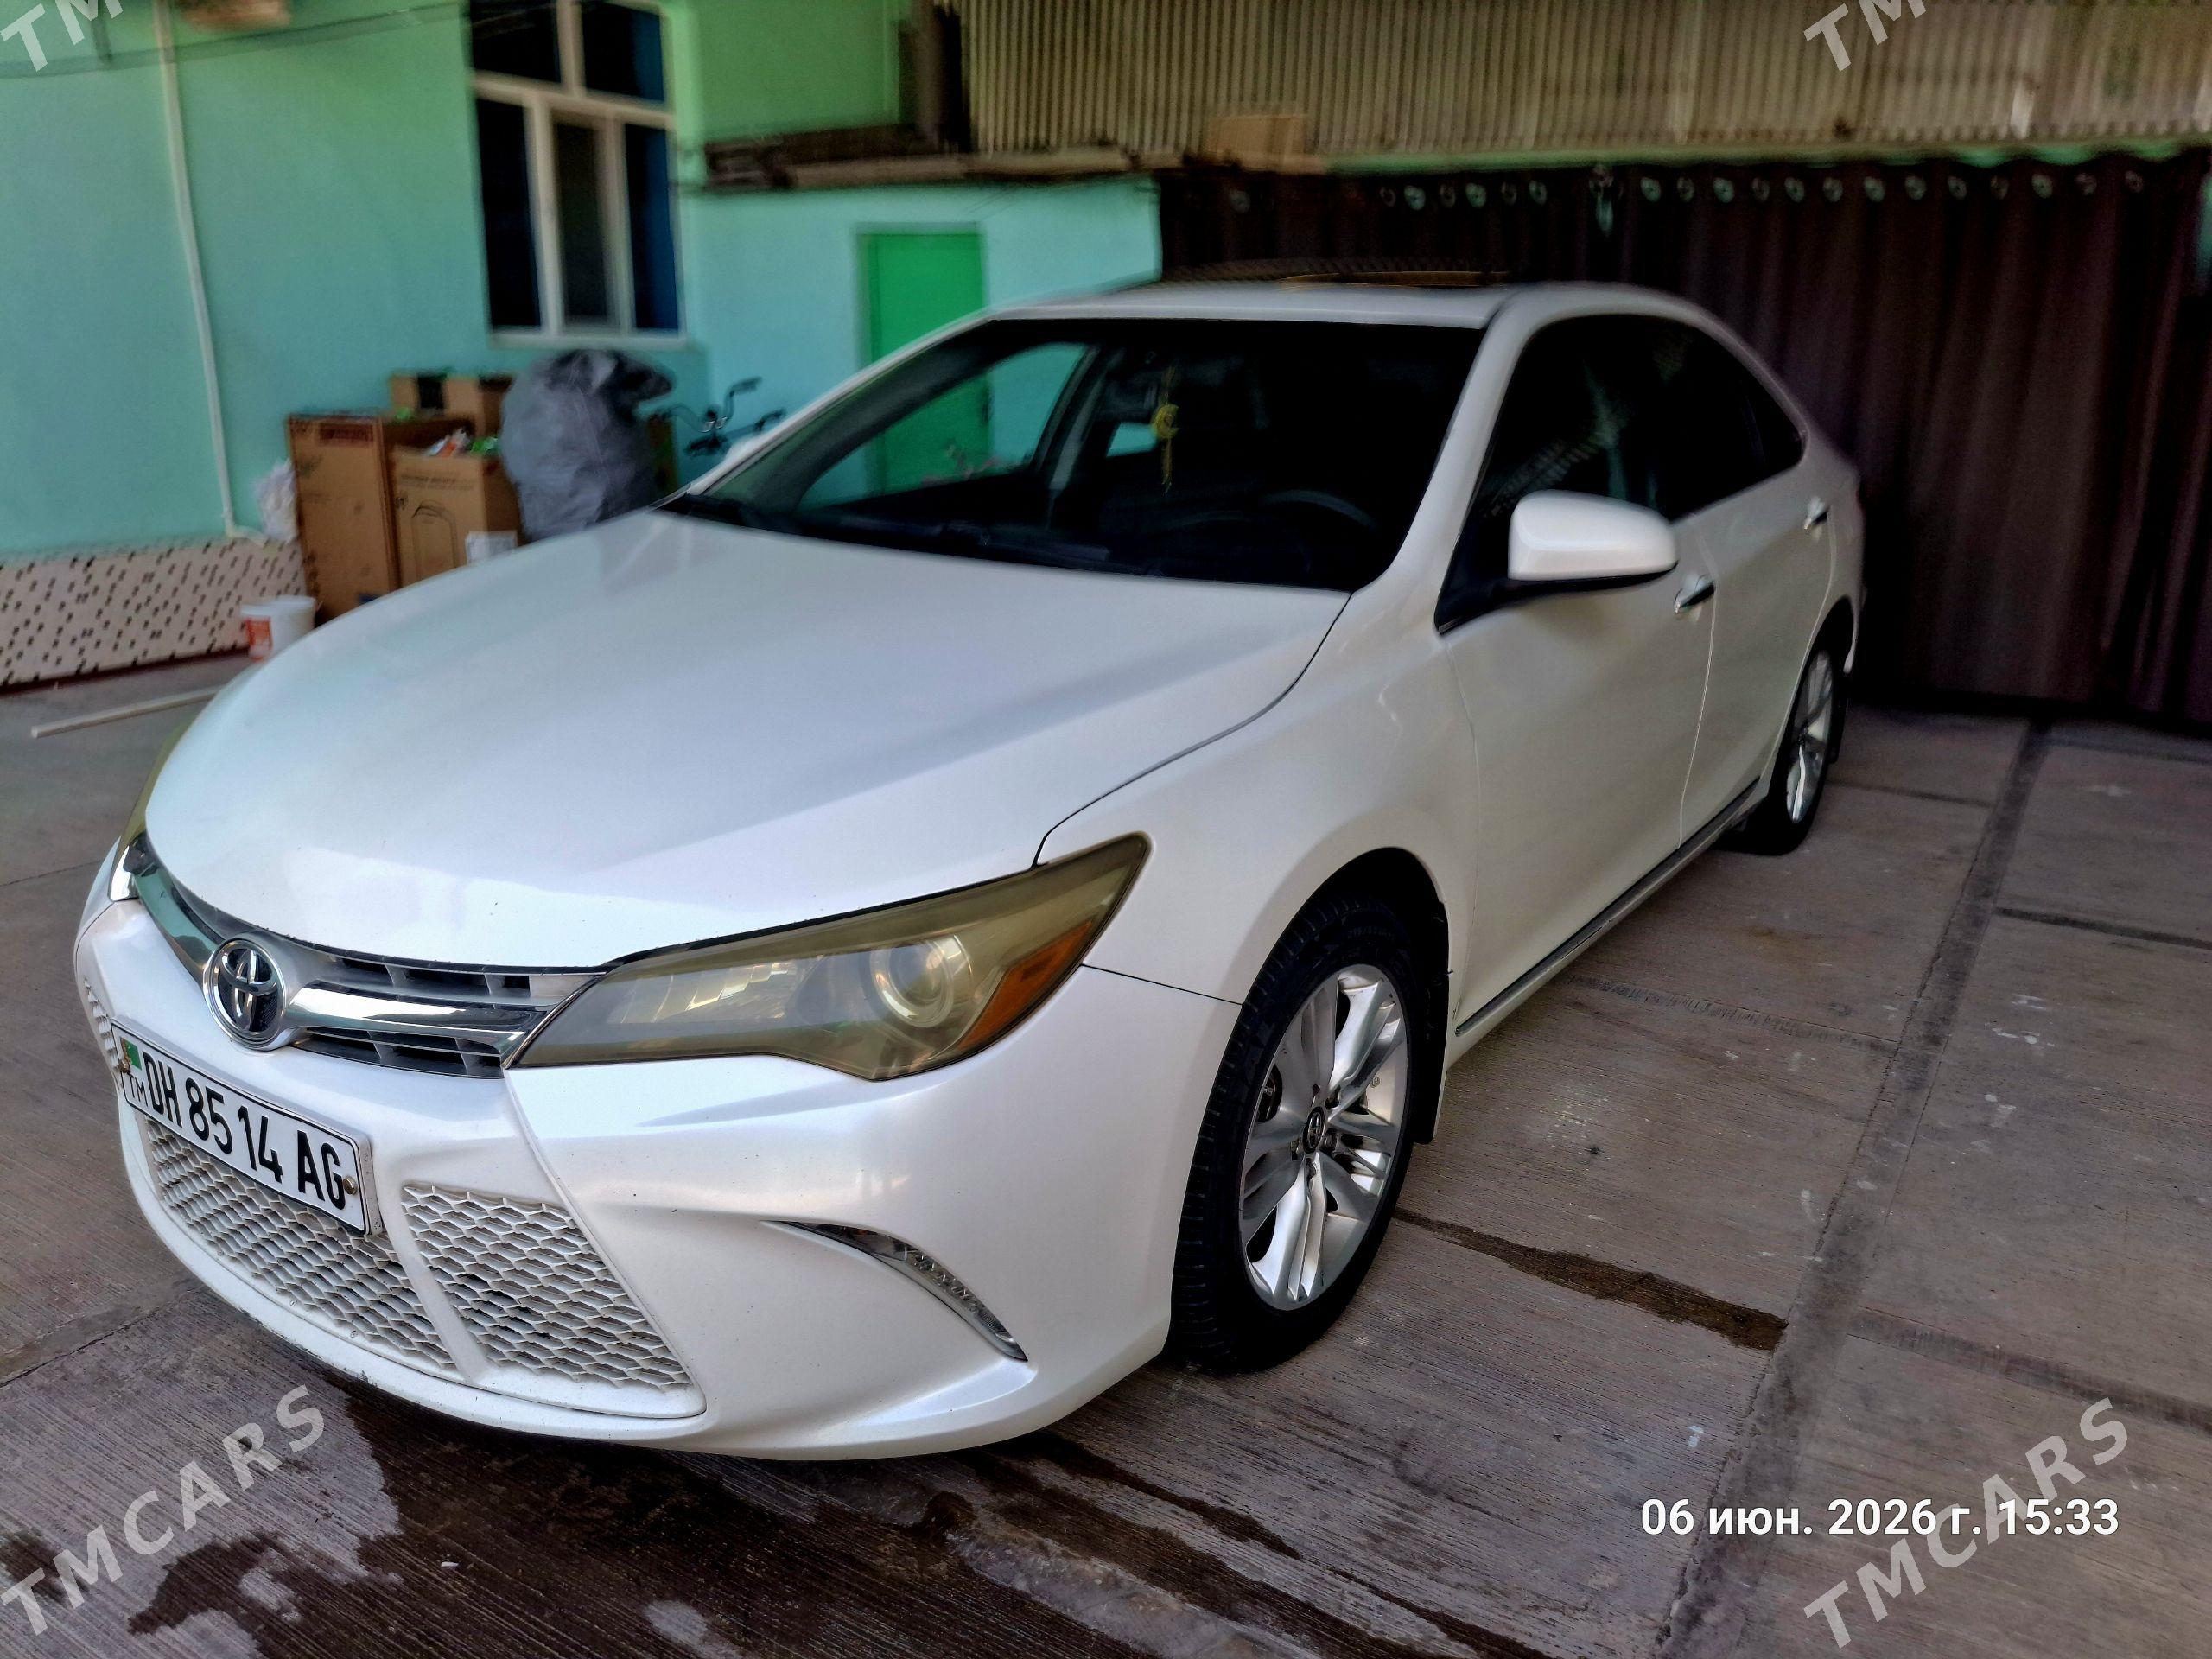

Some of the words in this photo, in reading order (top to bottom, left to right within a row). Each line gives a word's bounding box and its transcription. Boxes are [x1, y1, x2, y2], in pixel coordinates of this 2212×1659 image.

[127, 1072, 149, 1108] TM
[142, 1050, 183, 1128] DH
[185, 1077, 283, 1184] 8514
[296, 1128, 346, 1211] AG
